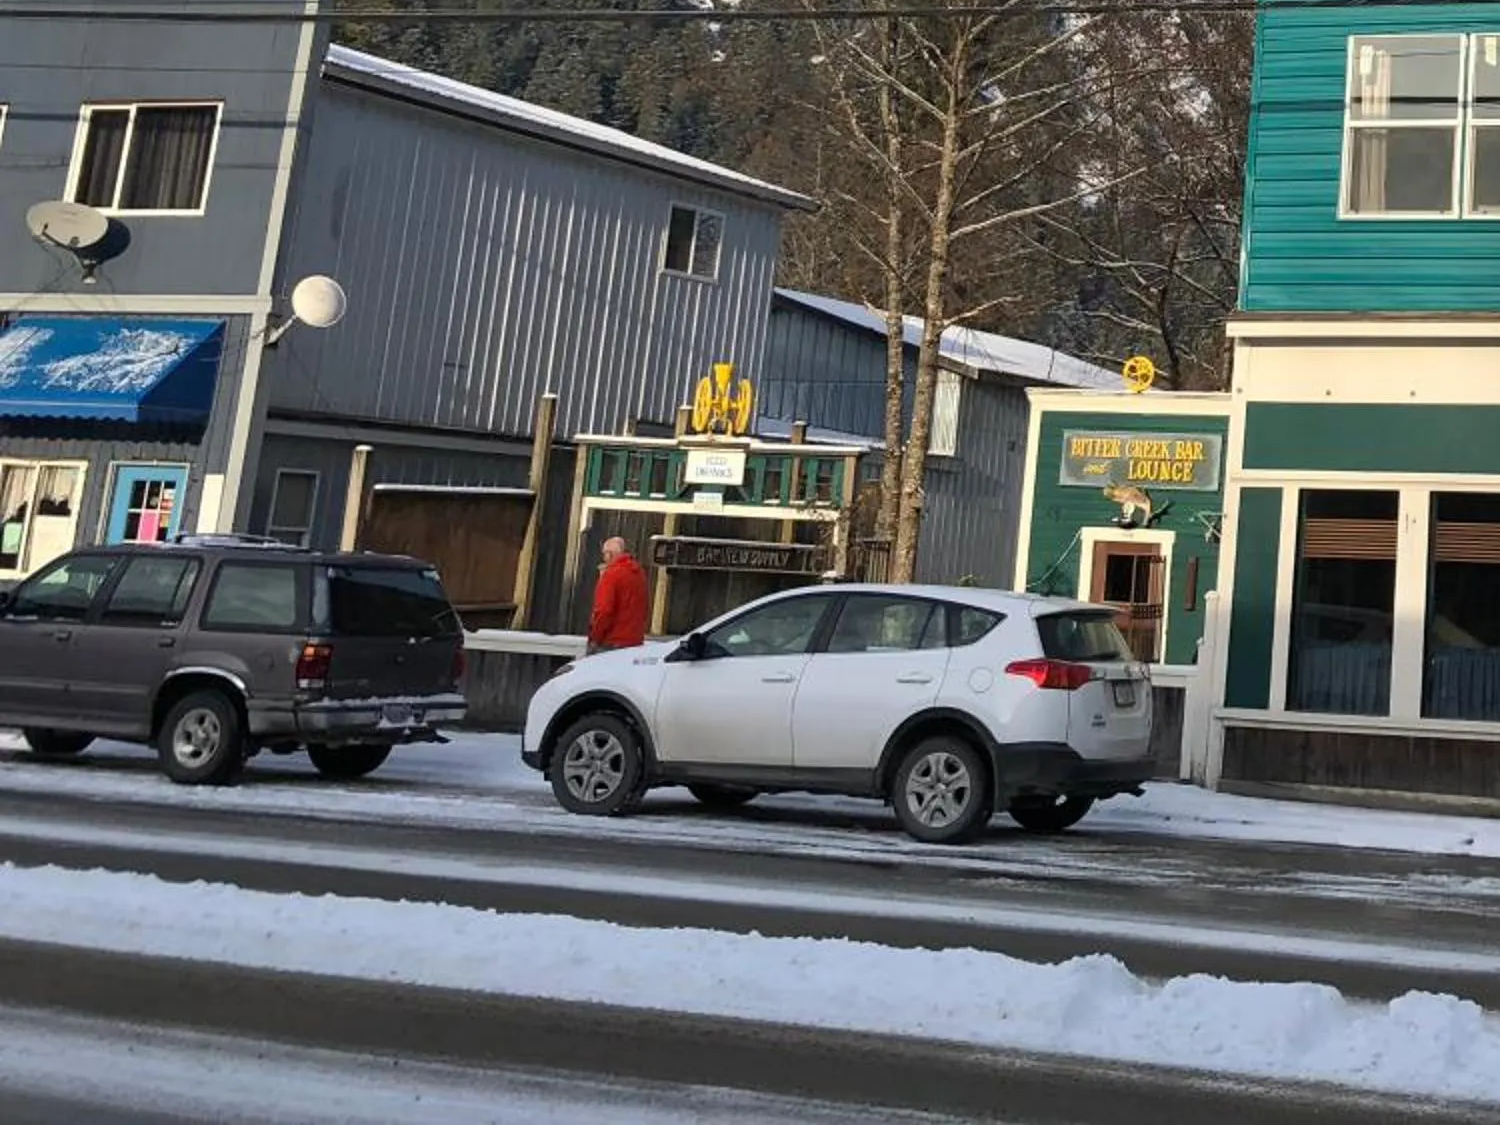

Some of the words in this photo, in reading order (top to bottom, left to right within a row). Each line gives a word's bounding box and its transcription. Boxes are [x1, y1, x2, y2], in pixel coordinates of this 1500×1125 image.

[1070, 437, 1121, 458] BITTER
[1125, 439, 1171, 460] CREEK
[1174, 440, 1206, 461] BAR
[1127, 459, 1194, 482] LOUNGE
